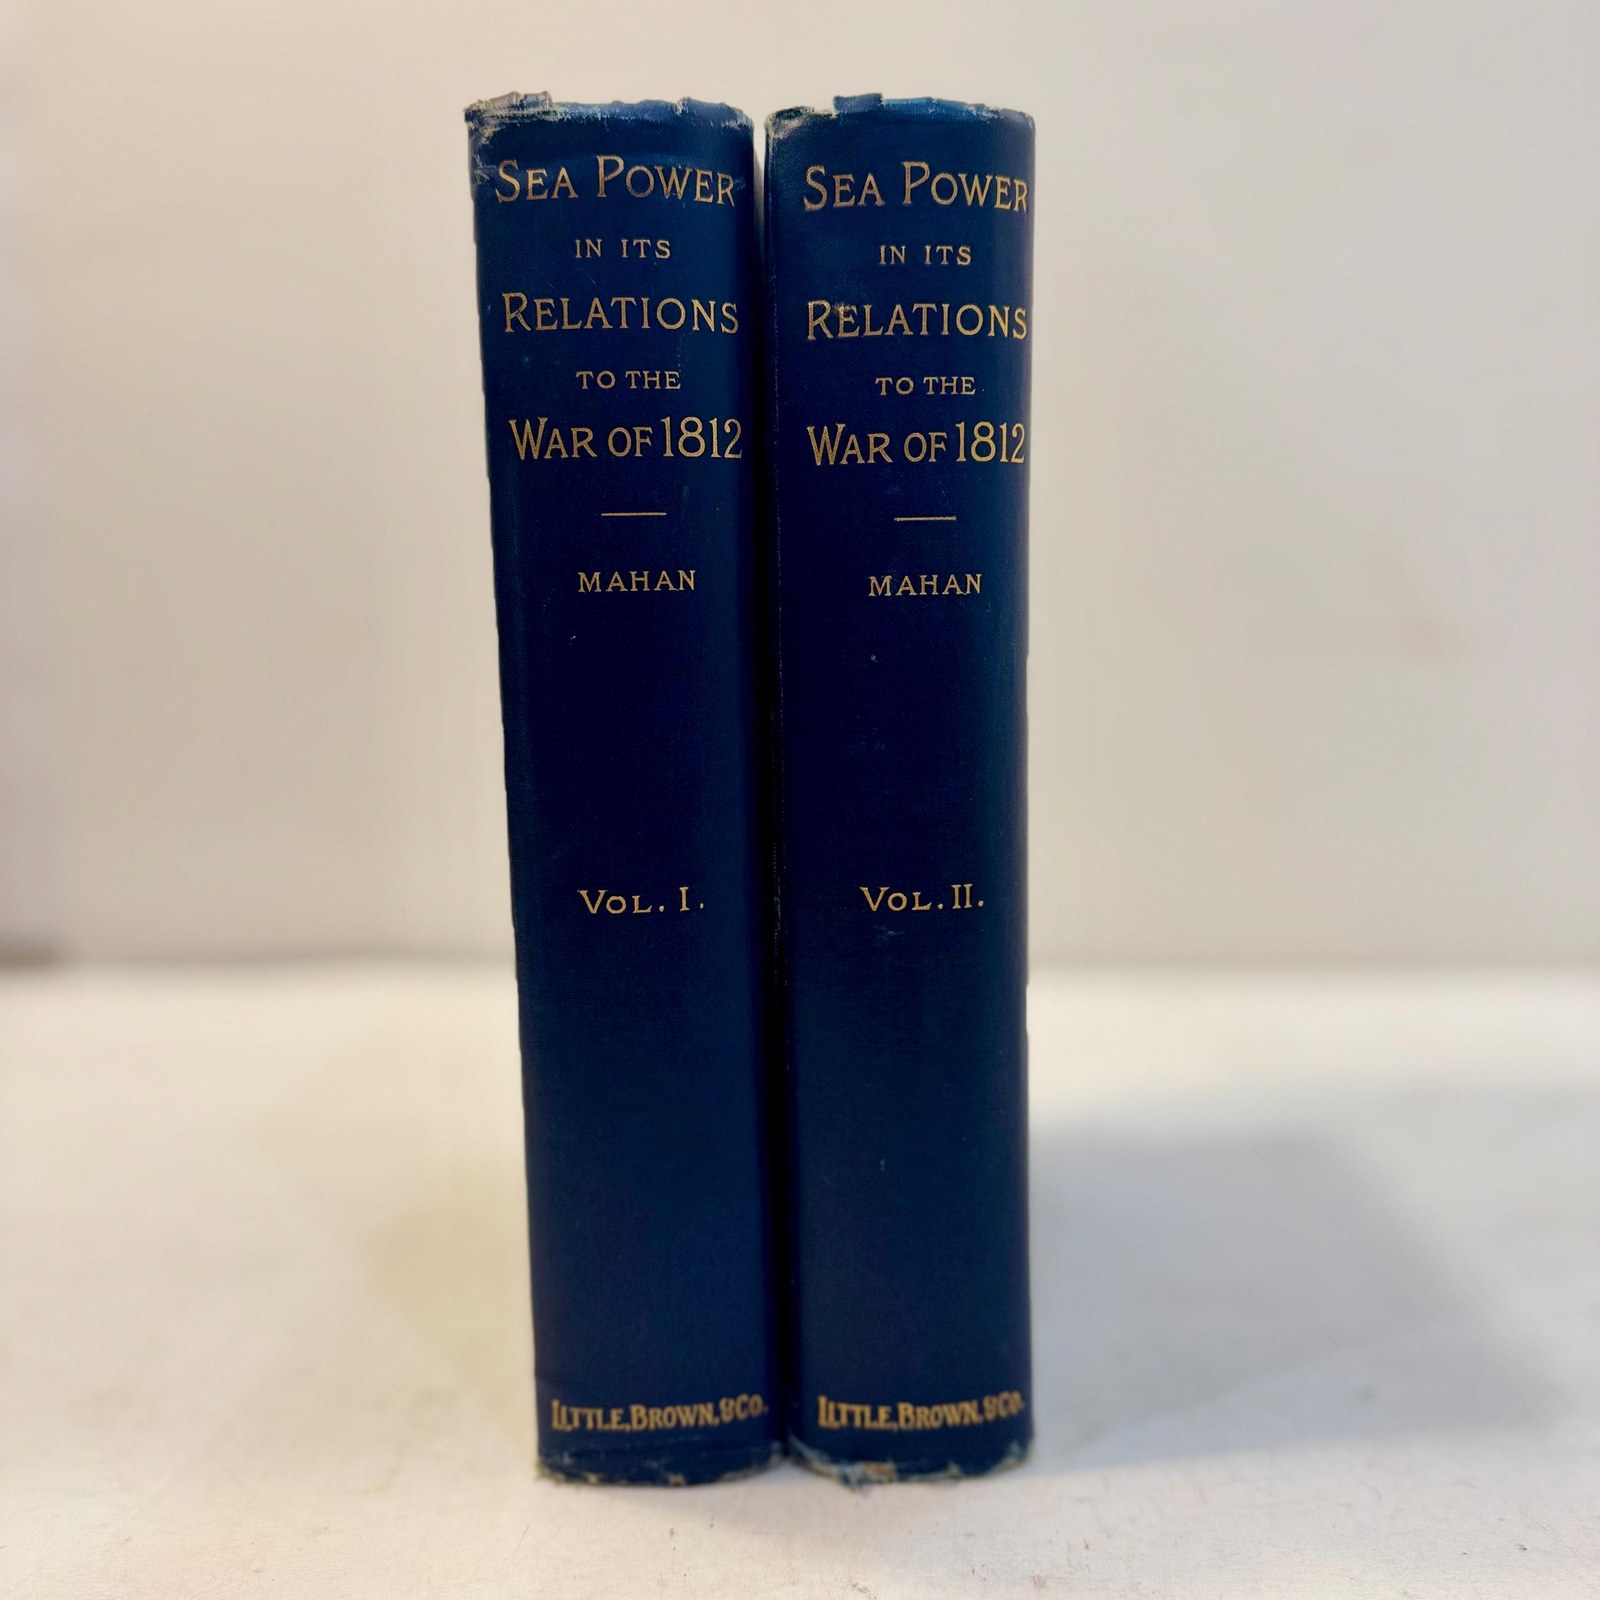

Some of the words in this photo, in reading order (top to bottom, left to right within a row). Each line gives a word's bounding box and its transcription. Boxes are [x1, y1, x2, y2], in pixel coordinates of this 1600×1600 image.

[495, 159, 578, 204] SEA
[597, 155, 736, 206] POWER
[804, 165, 885, 211] SEA
[902, 161, 1028, 213] POWER
[575, 239, 602, 258] IN
[621, 239, 671, 259] ITS
[879, 245, 906, 265] IN
[925, 245, 972, 266] ITS
[502, 292, 739, 335] RELATIONS
[807, 300, 1028, 341] RELATIONS
[576, 371, 616, 390] TO
[626, 371, 681, 390] THE
[876, 376, 914, 395] TO
[924, 376, 975, 395] THE
[509, 417, 597, 460] WAR
[607, 426, 653, 457] OF
[661, 416, 742, 460] 1812
[807, 423, 893, 466] WAR
[903, 431, 948, 463] OF
[956, 421, 1027, 464] 1812
[578, 570, 696, 593] MAHAN
[868, 573, 982, 596] MAHAN
[578, 889, 665, 914] VOL.
[679, 886, 704, 912] I.
[860, 886, 944, 912] VOL.
[952, 883, 985, 909] II.
